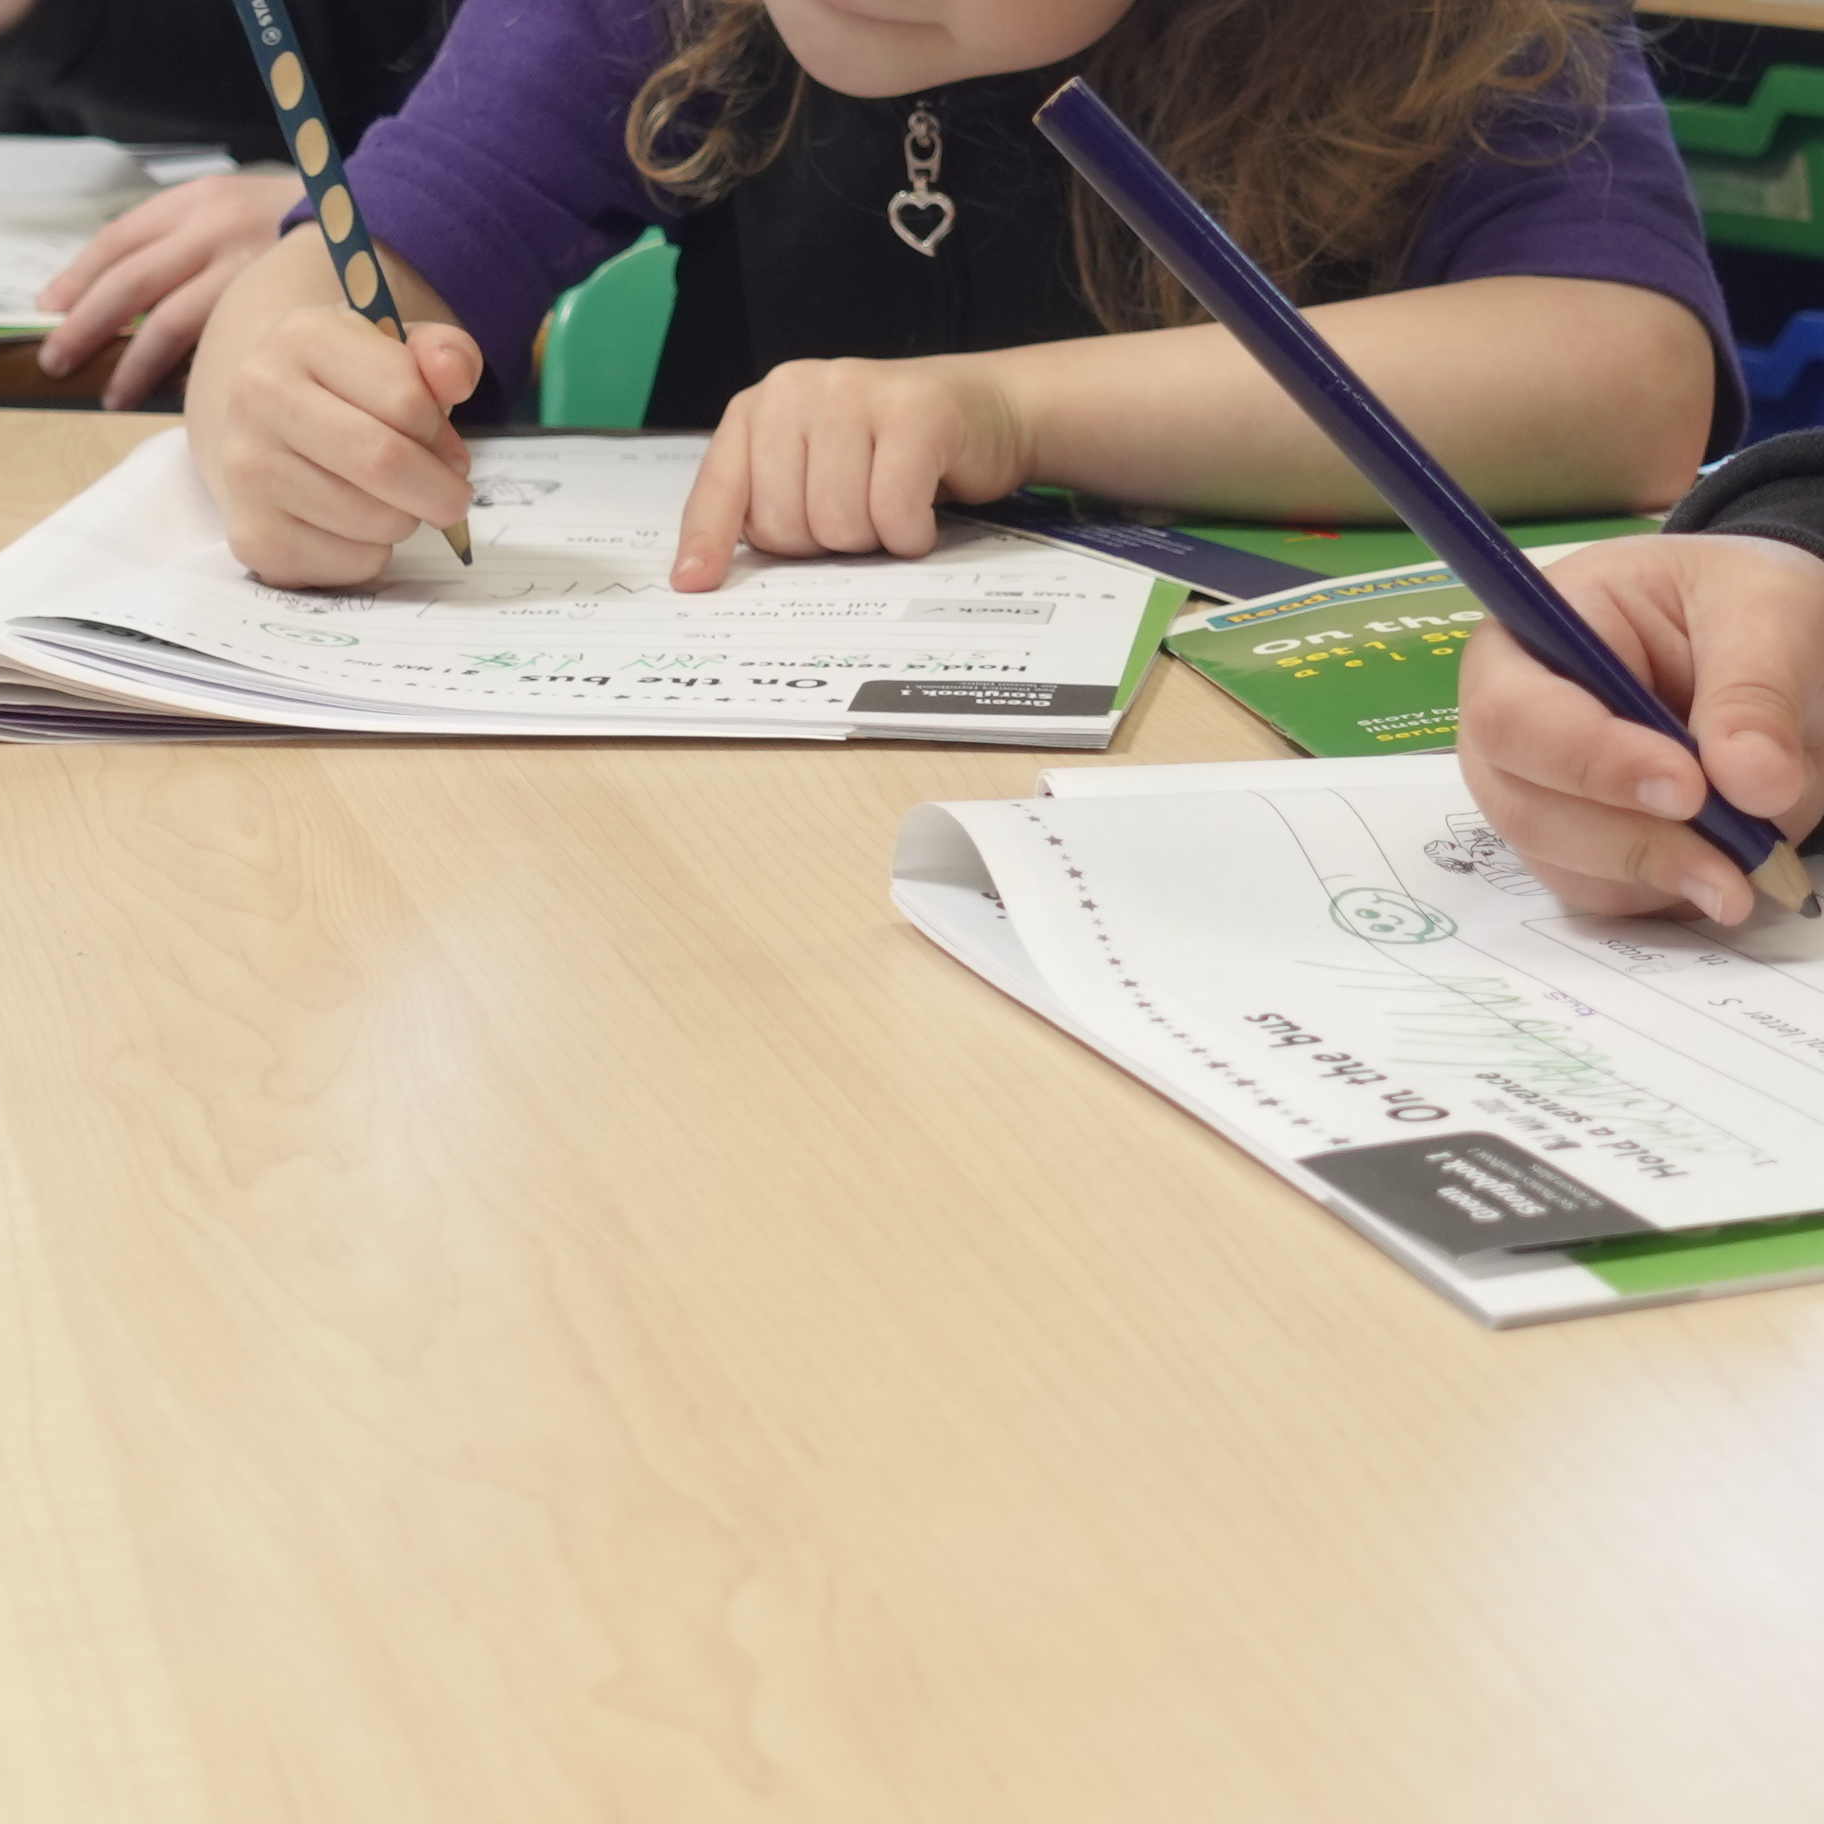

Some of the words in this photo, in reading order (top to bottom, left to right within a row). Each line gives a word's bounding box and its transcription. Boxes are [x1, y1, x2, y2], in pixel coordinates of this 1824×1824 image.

[1226, 594, 1331, 623] Read
[1332, 573, 1451, 598] Write
[958, 606, 1040, 615] Check
[1252, 629, 1354, 655] On
[1364, 610, 1485, 633] the
[738, 660, 893, 670] sentence
[1276, 646, 1354, 668] Set
[942, 664, 1028, 672] Hold
[517, 674, 612, 686] bus
[636, 675, 723, 687] the
[747, 677, 829, 690] On
[921, 688, 1054, 701] Storybook
[975, 697, 1052, 708] Green
[1356, 711, 1425, 727] Story
[1598, 936, 1665, 963] gaps
[1692, 952, 1730, 967] th
[1707, 997, 1743, 1007] S
[1243, 1012, 1323, 1049] bus
[1741, 1008, 1807, 1037] letter
[1311, 1051, 1388, 1085] the
[1380, 1088, 1451, 1123] On
[1475, 1071, 1593, 1124] sentence
[1586, 1126, 1616, 1136] a
[1424, 1150, 1453, 1162] 1
[1596, 1138, 1690, 1180] Hold
[1440, 1157, 1549, 1218] Storybook
[1436, 1184, 1505, 1222] Green
